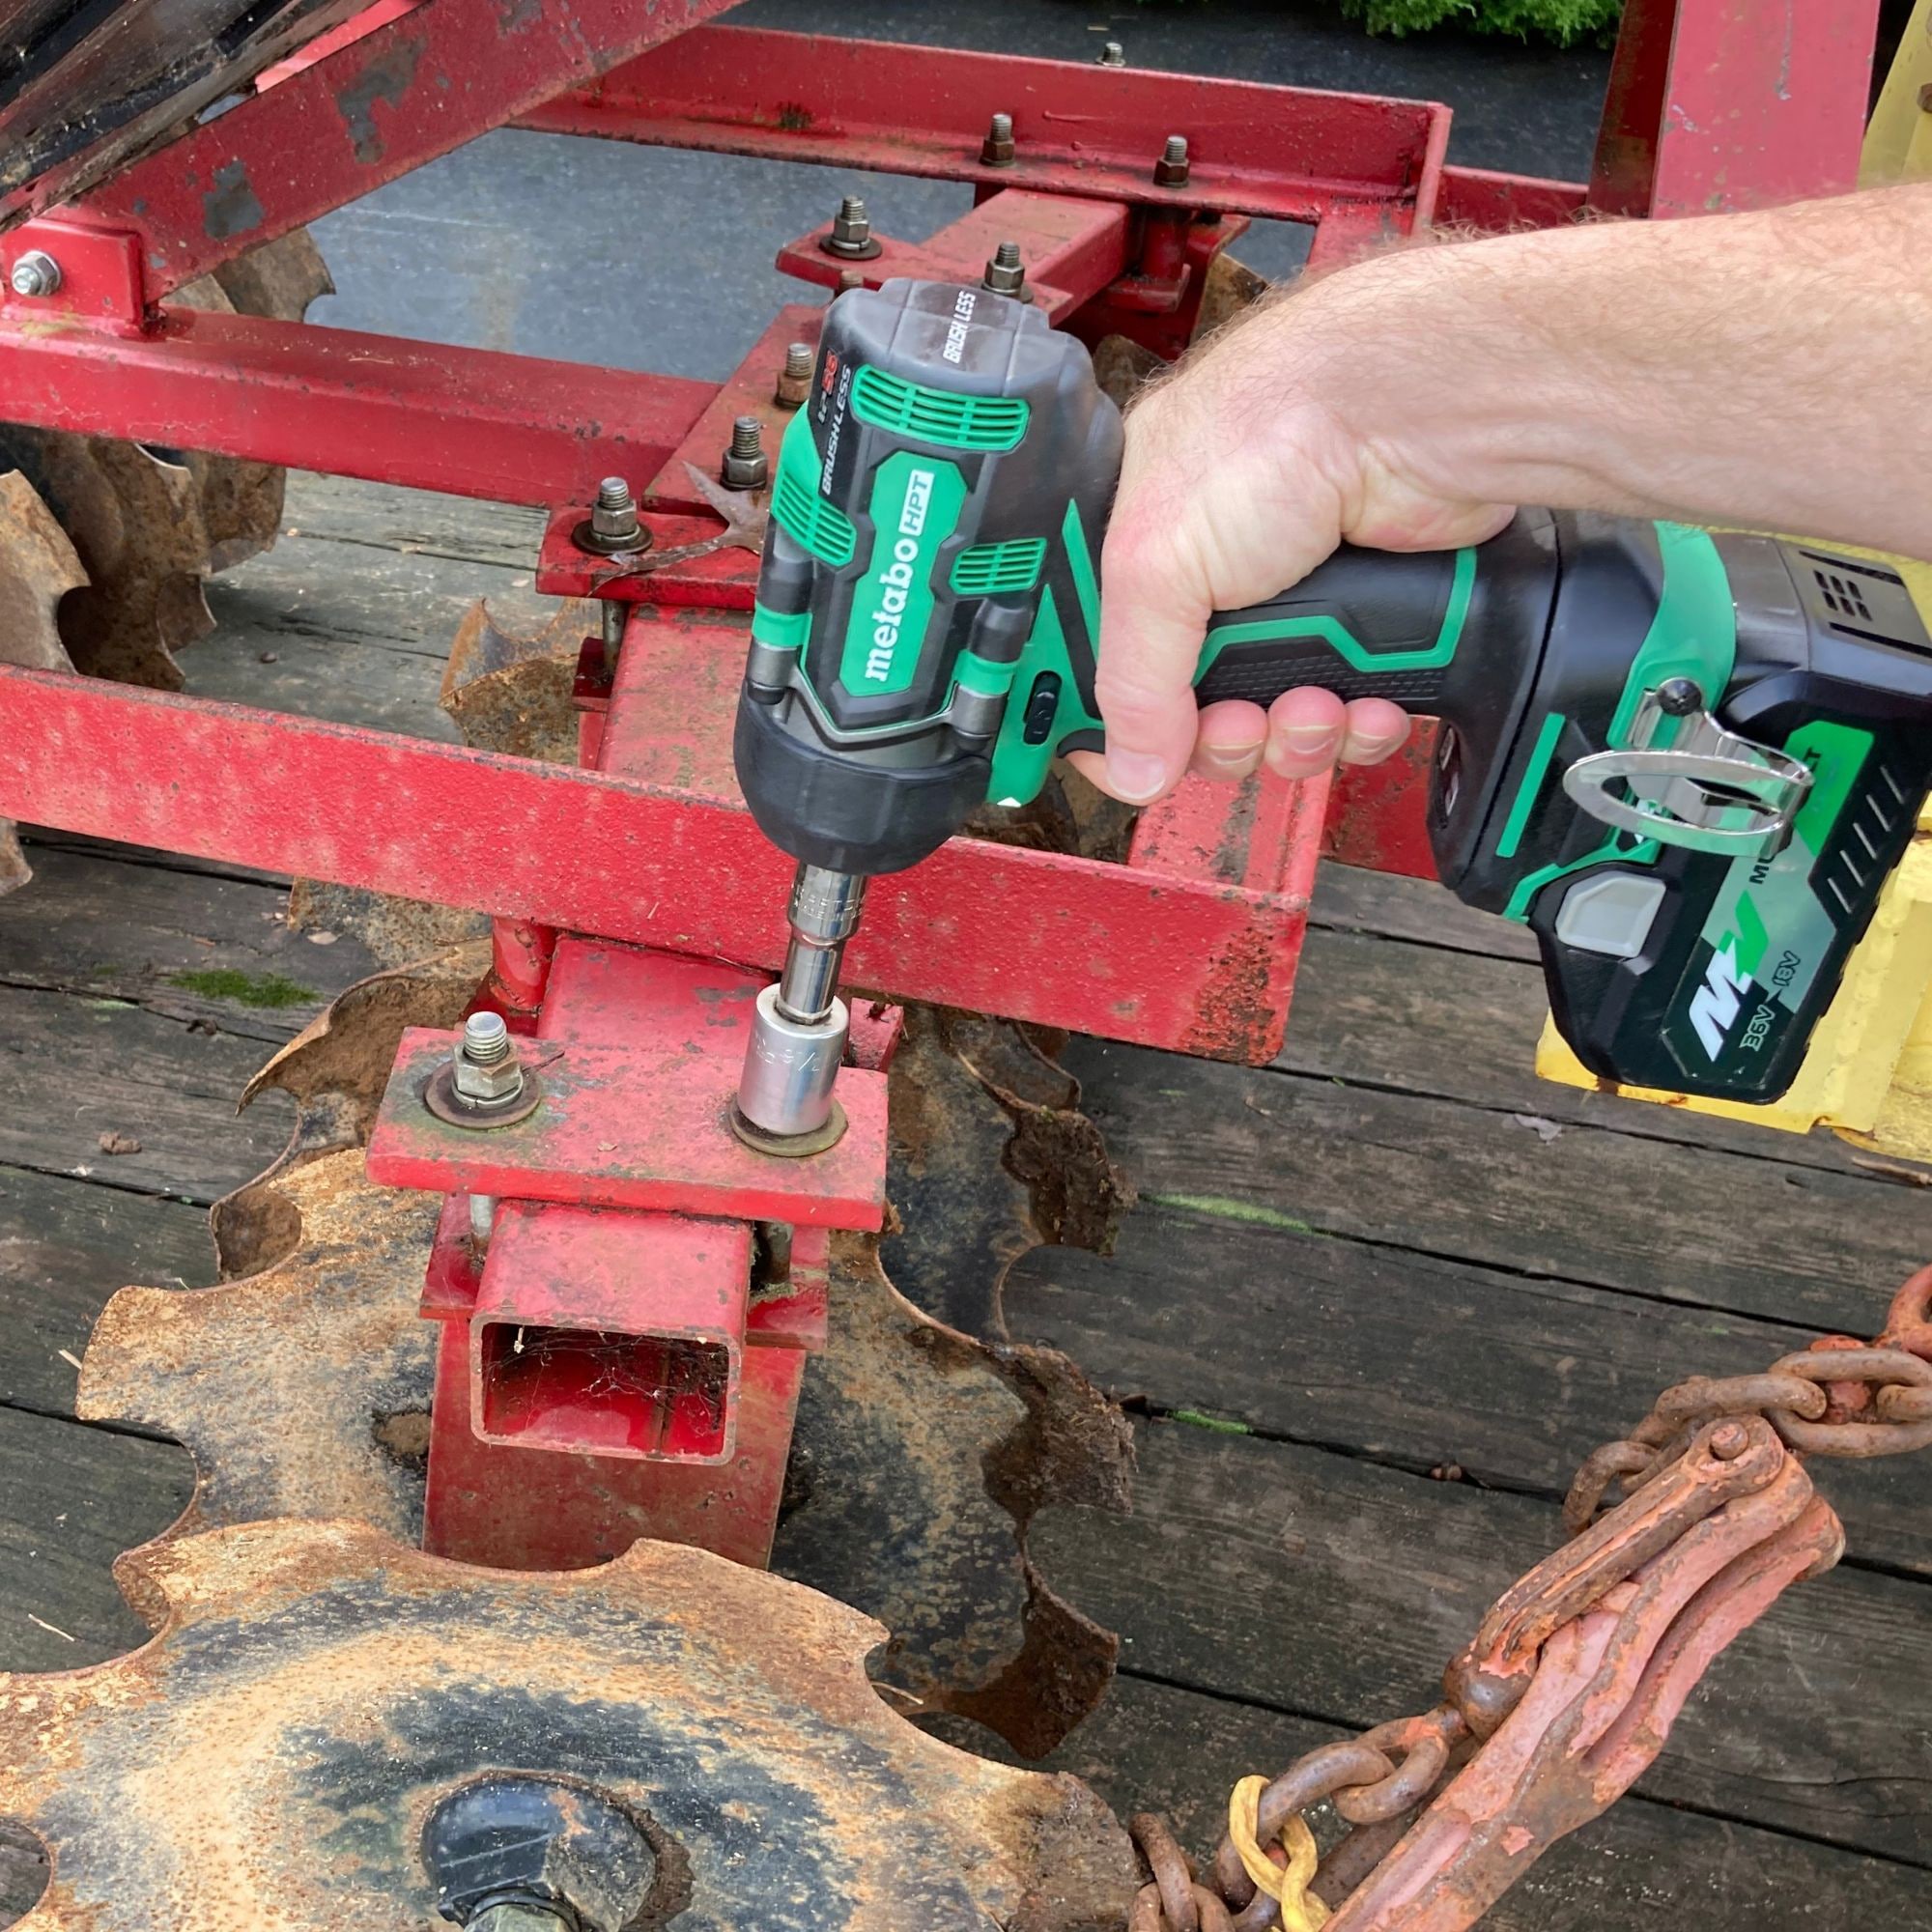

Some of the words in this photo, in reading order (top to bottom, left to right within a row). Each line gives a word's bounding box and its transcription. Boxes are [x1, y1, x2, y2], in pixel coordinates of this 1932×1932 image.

[821, 364, 851, 495] BRUSHLESS
[867, 538, 918, 682] metabo
[905, 473, 928, 530] HPT
[1740, 1005, 1776, 1052] 36V
[1773, 951, 1801, 986] 18V
